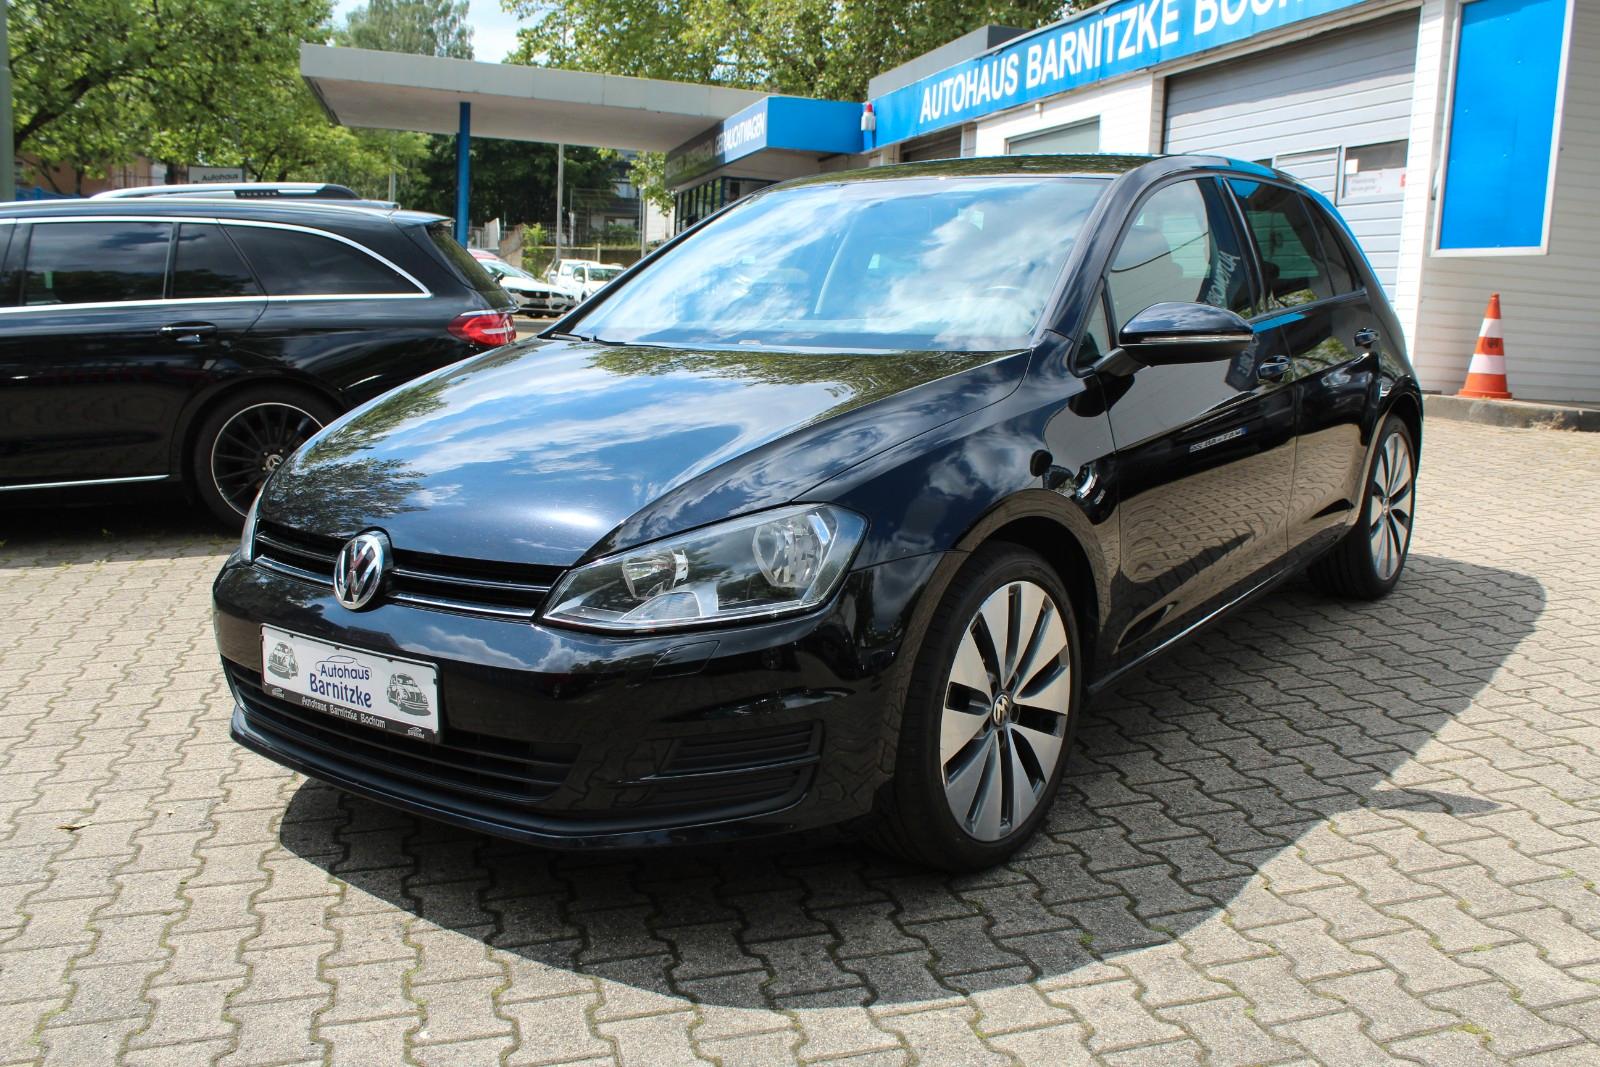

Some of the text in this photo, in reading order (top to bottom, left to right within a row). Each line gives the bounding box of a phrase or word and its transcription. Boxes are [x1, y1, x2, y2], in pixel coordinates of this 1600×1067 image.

[919, 54, 1019, 124] AUTOHAUS
[1026, 0, 1179, 89] BARNITZKE
[320, 664, 370, 680] Autohaus
[309, 673, 372, 708] Barnitzke
[301, 696, 386, 729] Autohaus Barnitzke Bochum
